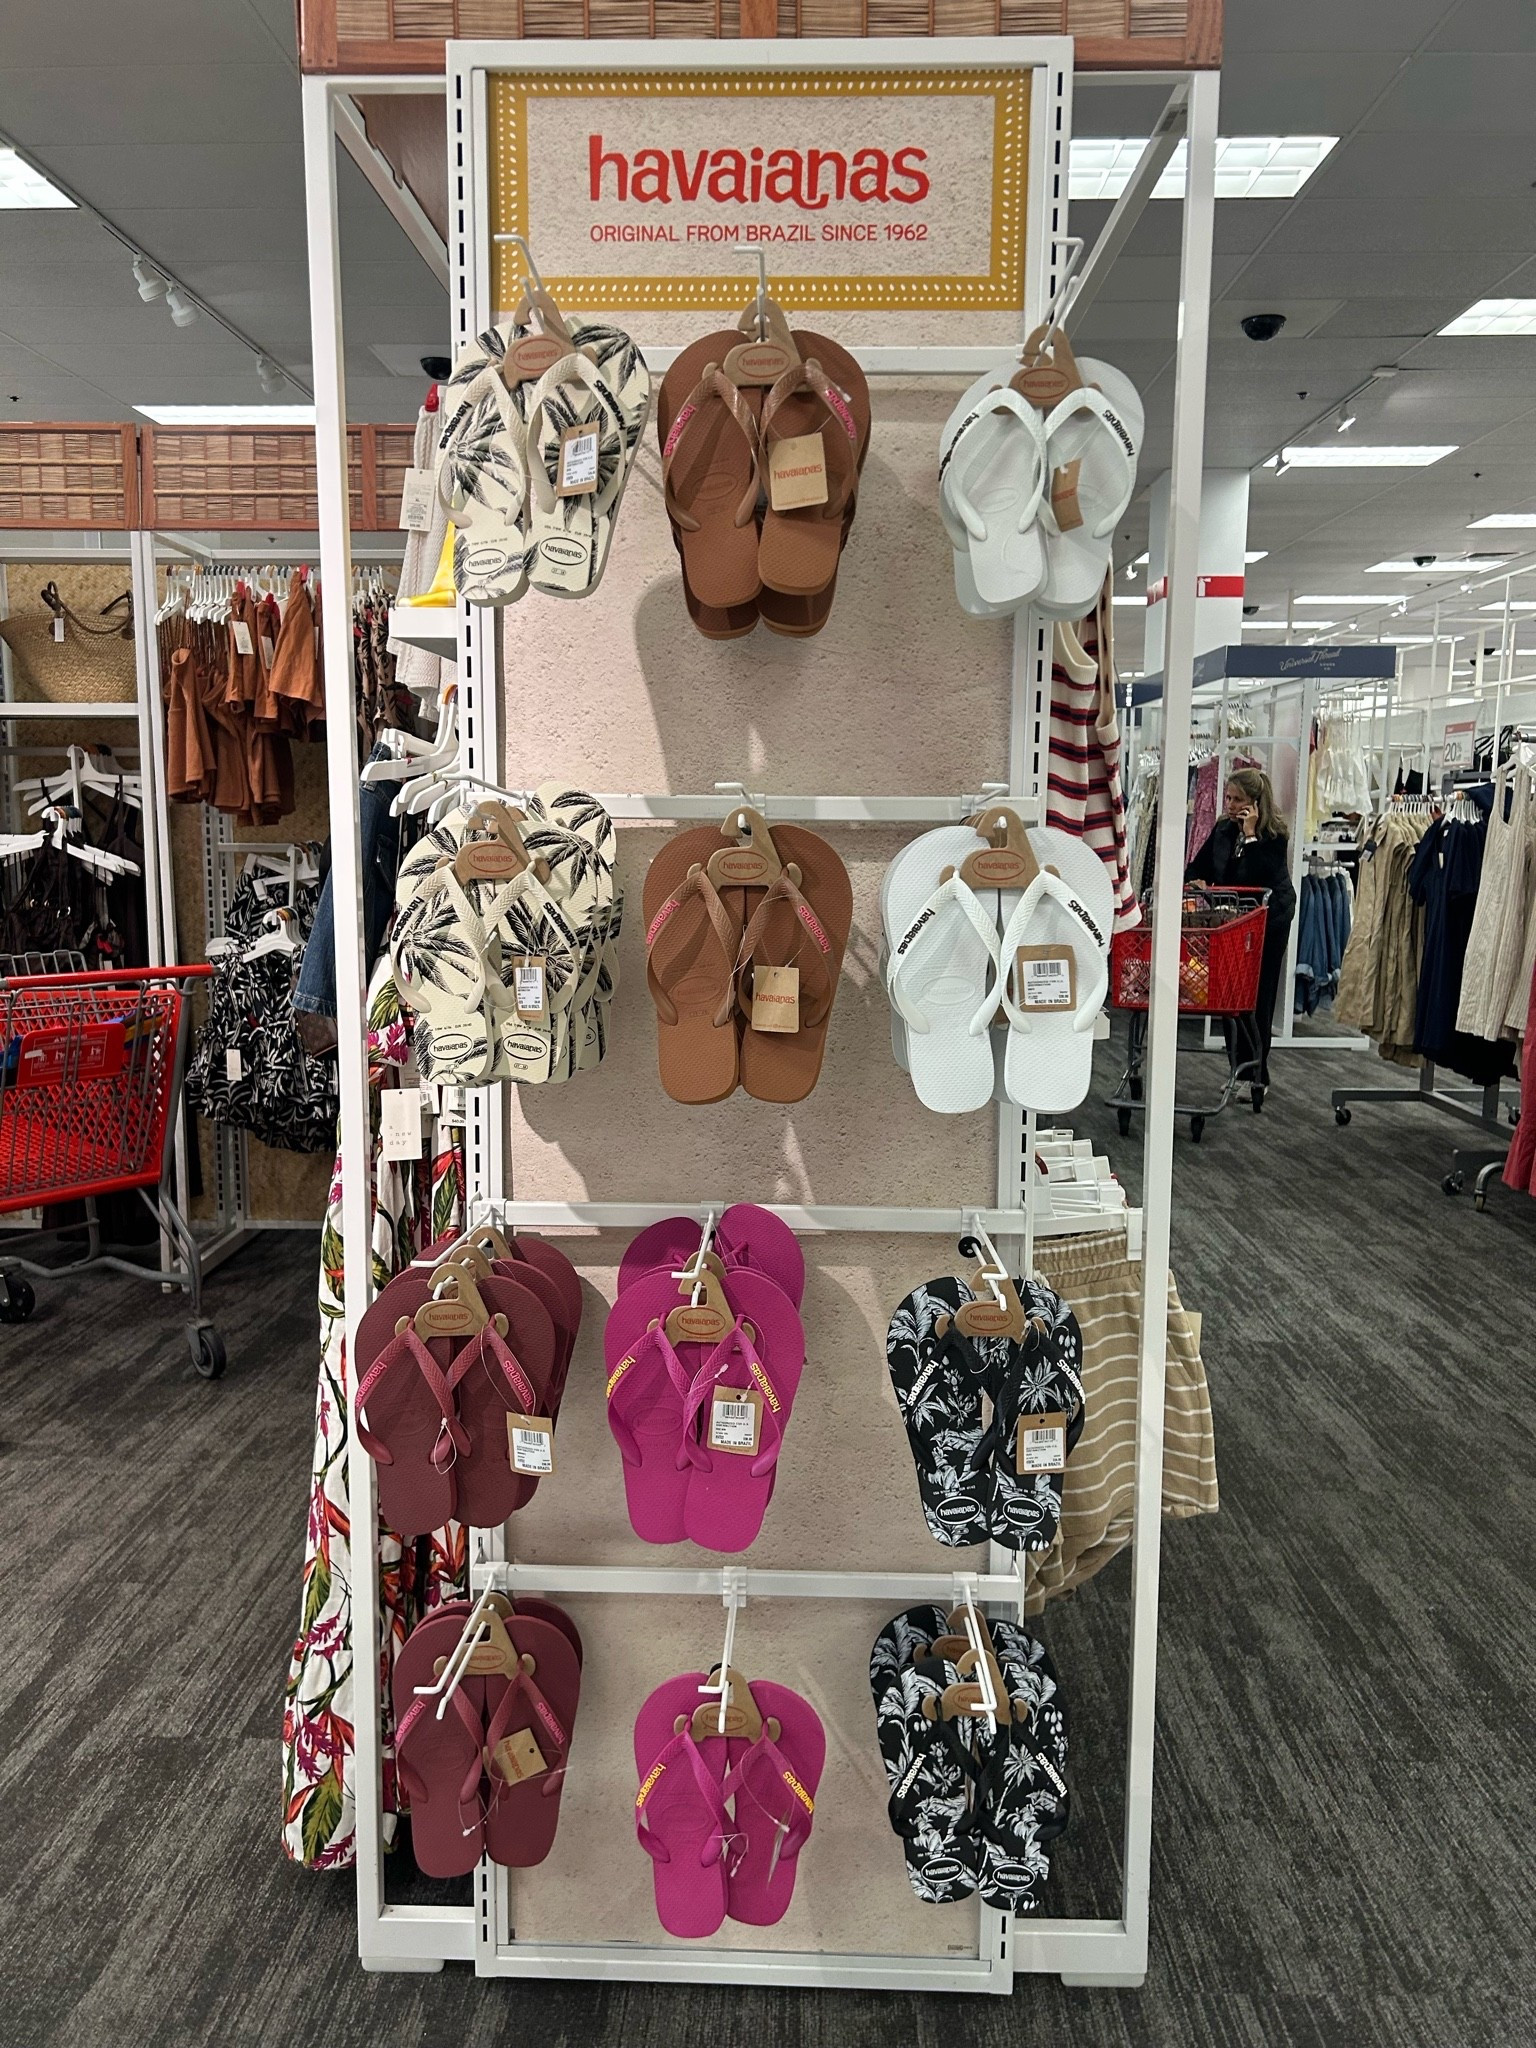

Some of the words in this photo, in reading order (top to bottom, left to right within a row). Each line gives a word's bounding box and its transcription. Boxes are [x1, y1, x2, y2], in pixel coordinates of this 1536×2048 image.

[589, 134, 930, 210] havaianas
[590, 224, 681, 242] ORIGINAL
[686, 224, 740, 242] FROM
[745, 224, 816, 242] BRAZIL
[821, 224, 878, 242] SINCE
[884, 224, 928, 242] 1962
[773, 463, 823, 480] havaianas
[544, 543, 583, 559] havaianas
[468, 556, 502, 568] havaianas
[472, 853, 513, 864] havaianas
[723, 860, 763, 871] havaianas
[977, 860, 1019, 871] havaianas
[543, 902, 576, 948] havaianas
[798, 905, 831, 954] havaianas
[897, 908, 936, 955] havaianas
[1067, 900, 1105, 948] havaianas
[755, 992, 795, 1005] havaianas
[433, 1041, 468, 1053] havaianas
[507, 1040, 543, 1054] havaianas
[428, 1311, 469, 1322] havaianas
[681, 1316, 721, 1327] havaianas
[969, 1312, 1008, 1323] havaianas
[504, 1360, 533, 1408] havaianas
[750, 1362, 781, 1413] havaianas
[907, 1359, 939, 1407] havaianas
[940, 1504, 976, 1517] havaianas
[1006, 1504, 1040, 1518] havaianas
[896, 1752, 927, 1800] havaianas
[1036, 1752, 1069, 1798] havaianas
[636, 1762, 666, 1808] havaianas
